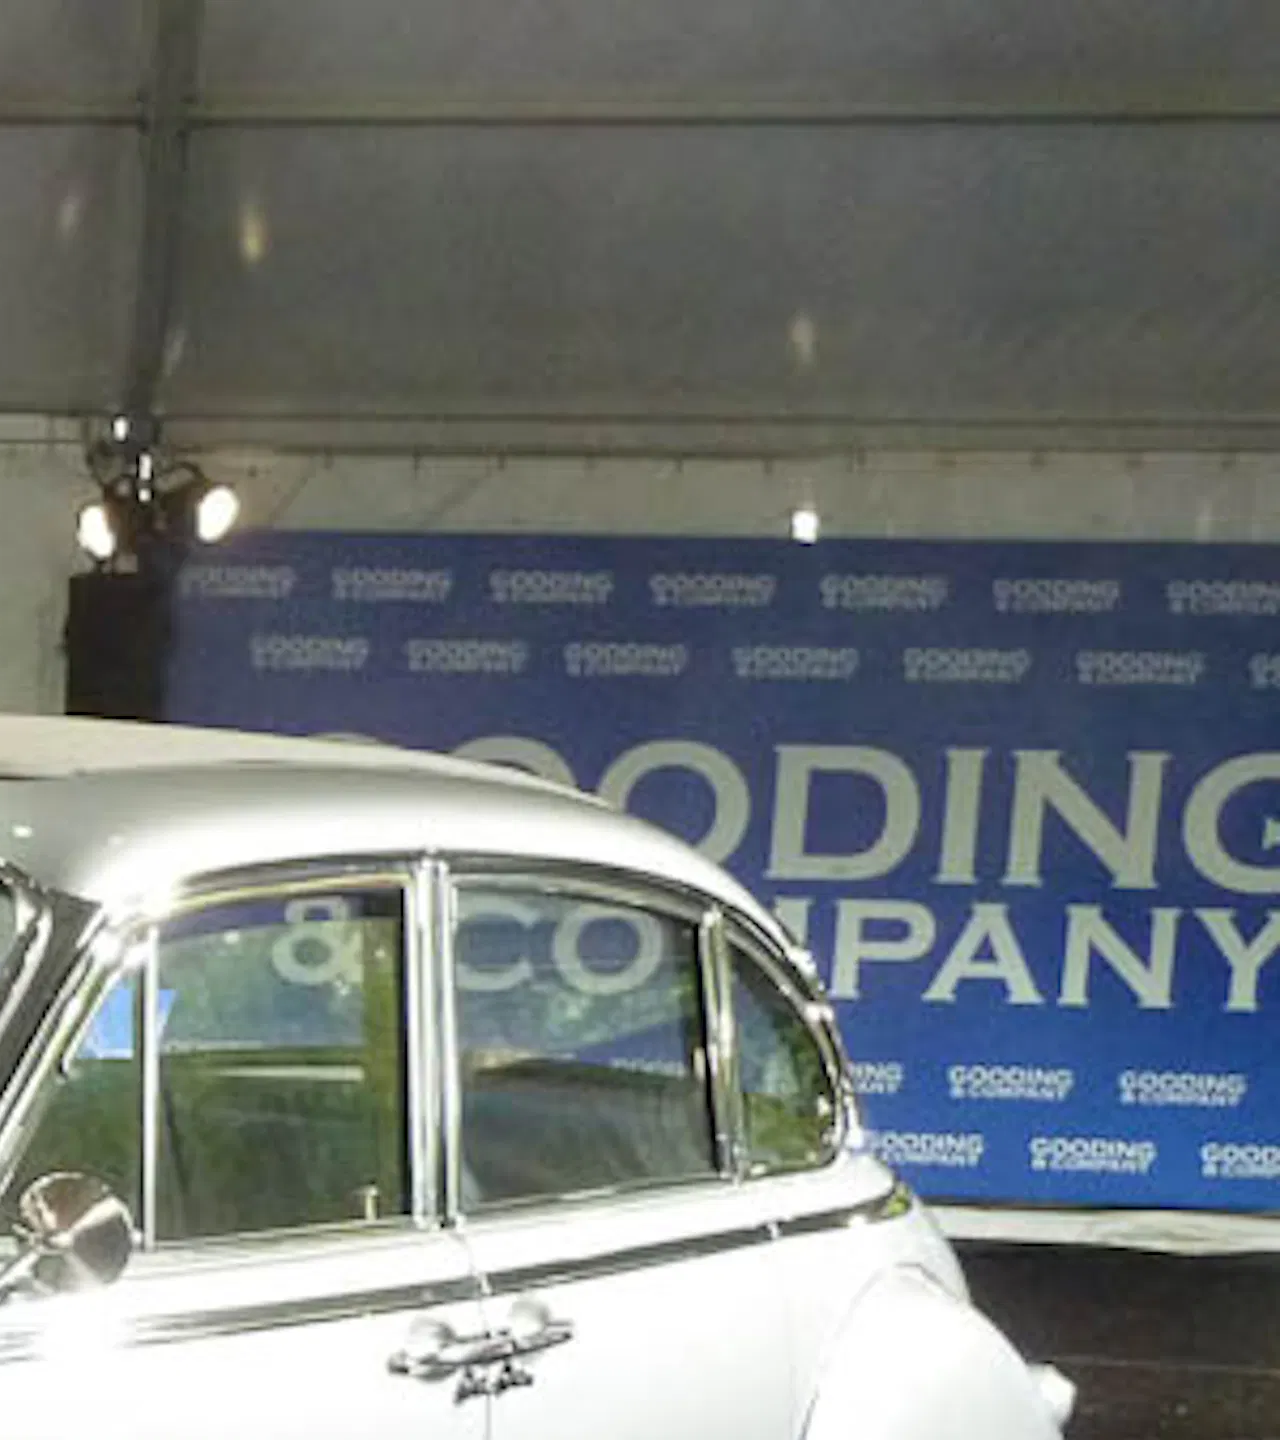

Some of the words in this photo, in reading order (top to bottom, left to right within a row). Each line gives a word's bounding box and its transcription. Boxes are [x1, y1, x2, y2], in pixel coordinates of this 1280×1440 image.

[305, 732, 1280, 894] ODING
[948, 1065, 1075, 1088] GOODING
[1120, 1070, 1247, 1093] GOODING
[1031, 1136, 1157, 1160] GOODING
